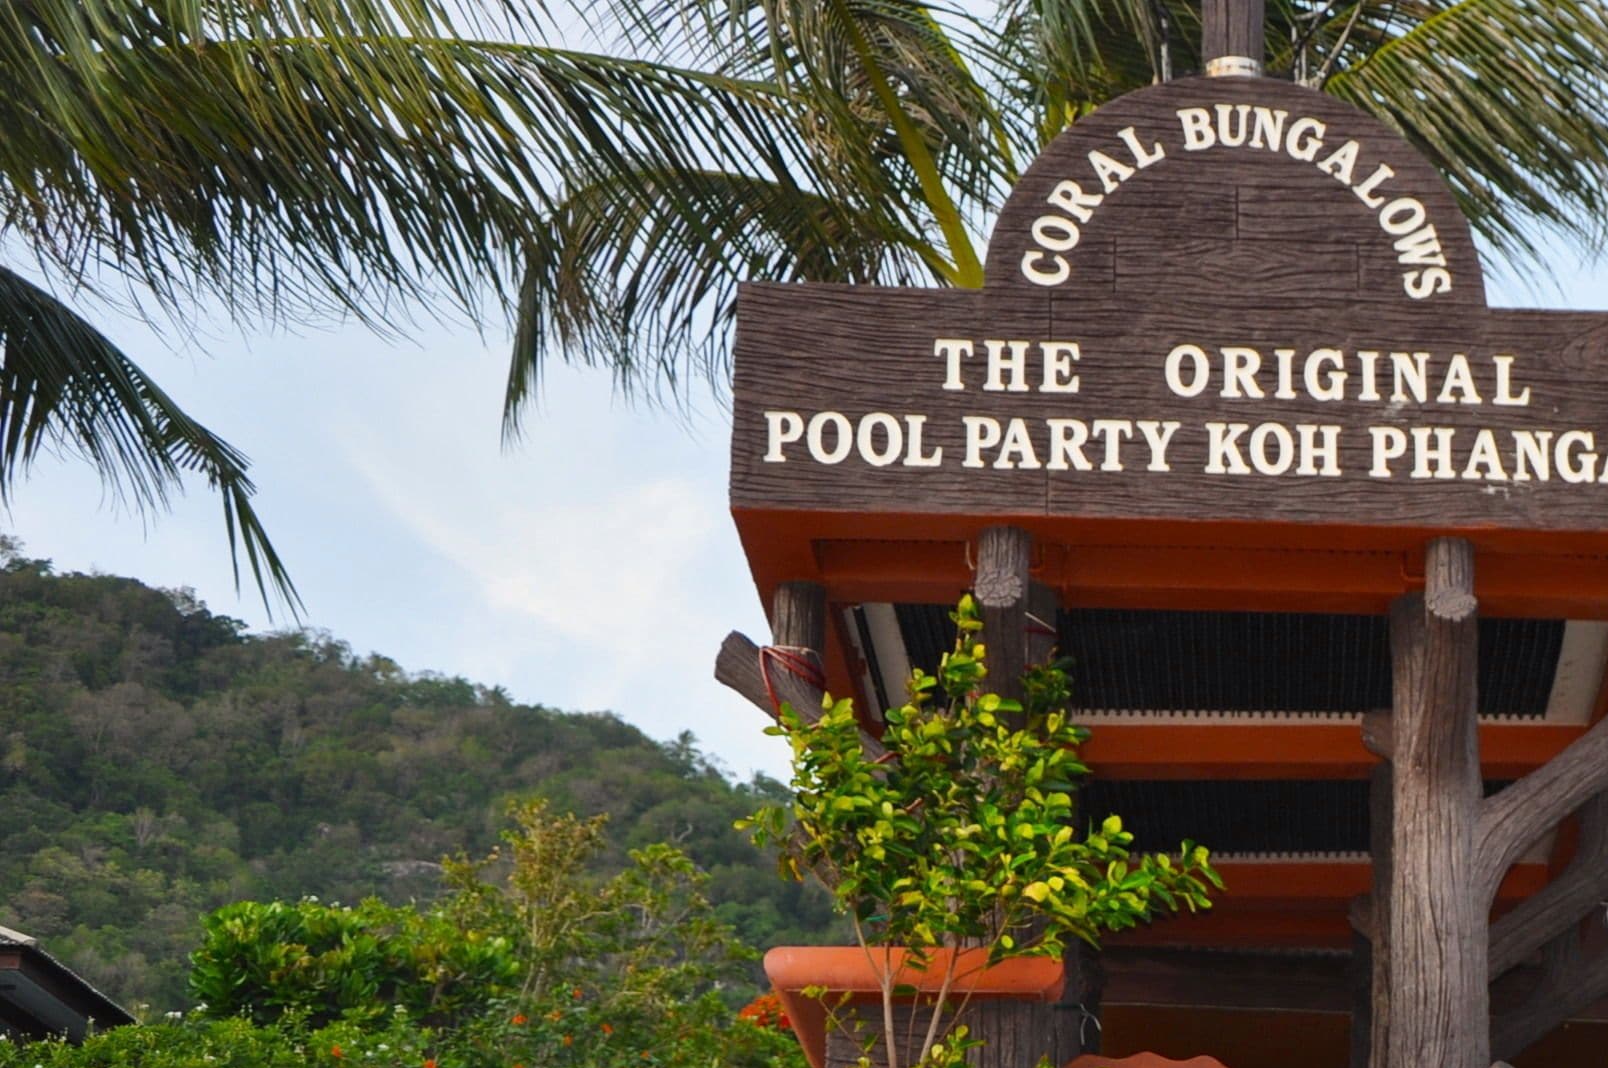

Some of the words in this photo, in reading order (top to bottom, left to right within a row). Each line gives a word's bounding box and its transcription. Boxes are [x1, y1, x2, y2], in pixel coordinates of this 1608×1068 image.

[1021, 127, 1165, 286] CORAL
[1176, 104, 1452, 299] BUNGALOWS
[934, 339, 1080, 393] THE
[1165, 345, 1530, 409] ORIGINAL
[764, 412, 942, 467] POOL
[962, 417, 1181, 472] PARTY
[1205, 423, 1341, 476] KOH
